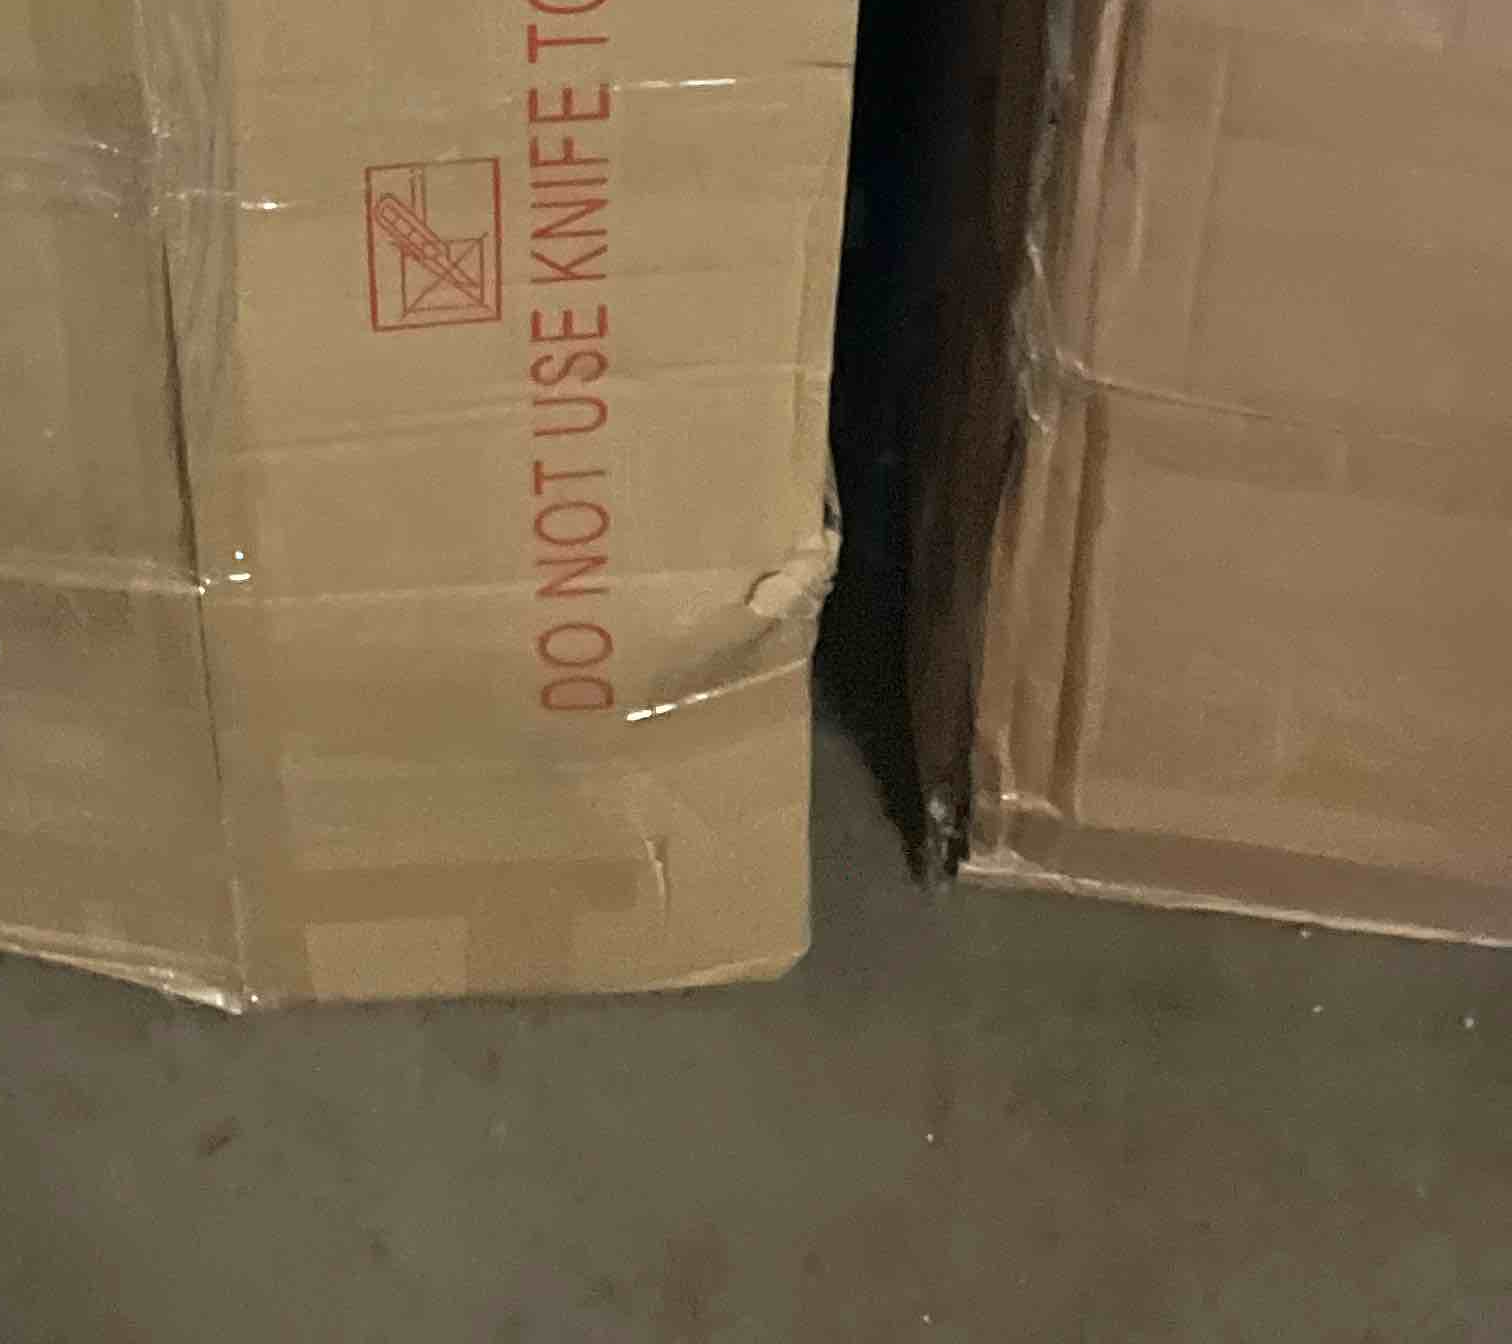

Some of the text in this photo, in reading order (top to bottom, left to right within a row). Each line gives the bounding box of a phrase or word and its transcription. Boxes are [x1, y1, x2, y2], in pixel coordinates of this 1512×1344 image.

[528, 82, 611, 285] KNIFE
[529, 303, 609, 439] USE
[532, 458, 610, 601] NOT
[537, 621, 615, 713] DO
